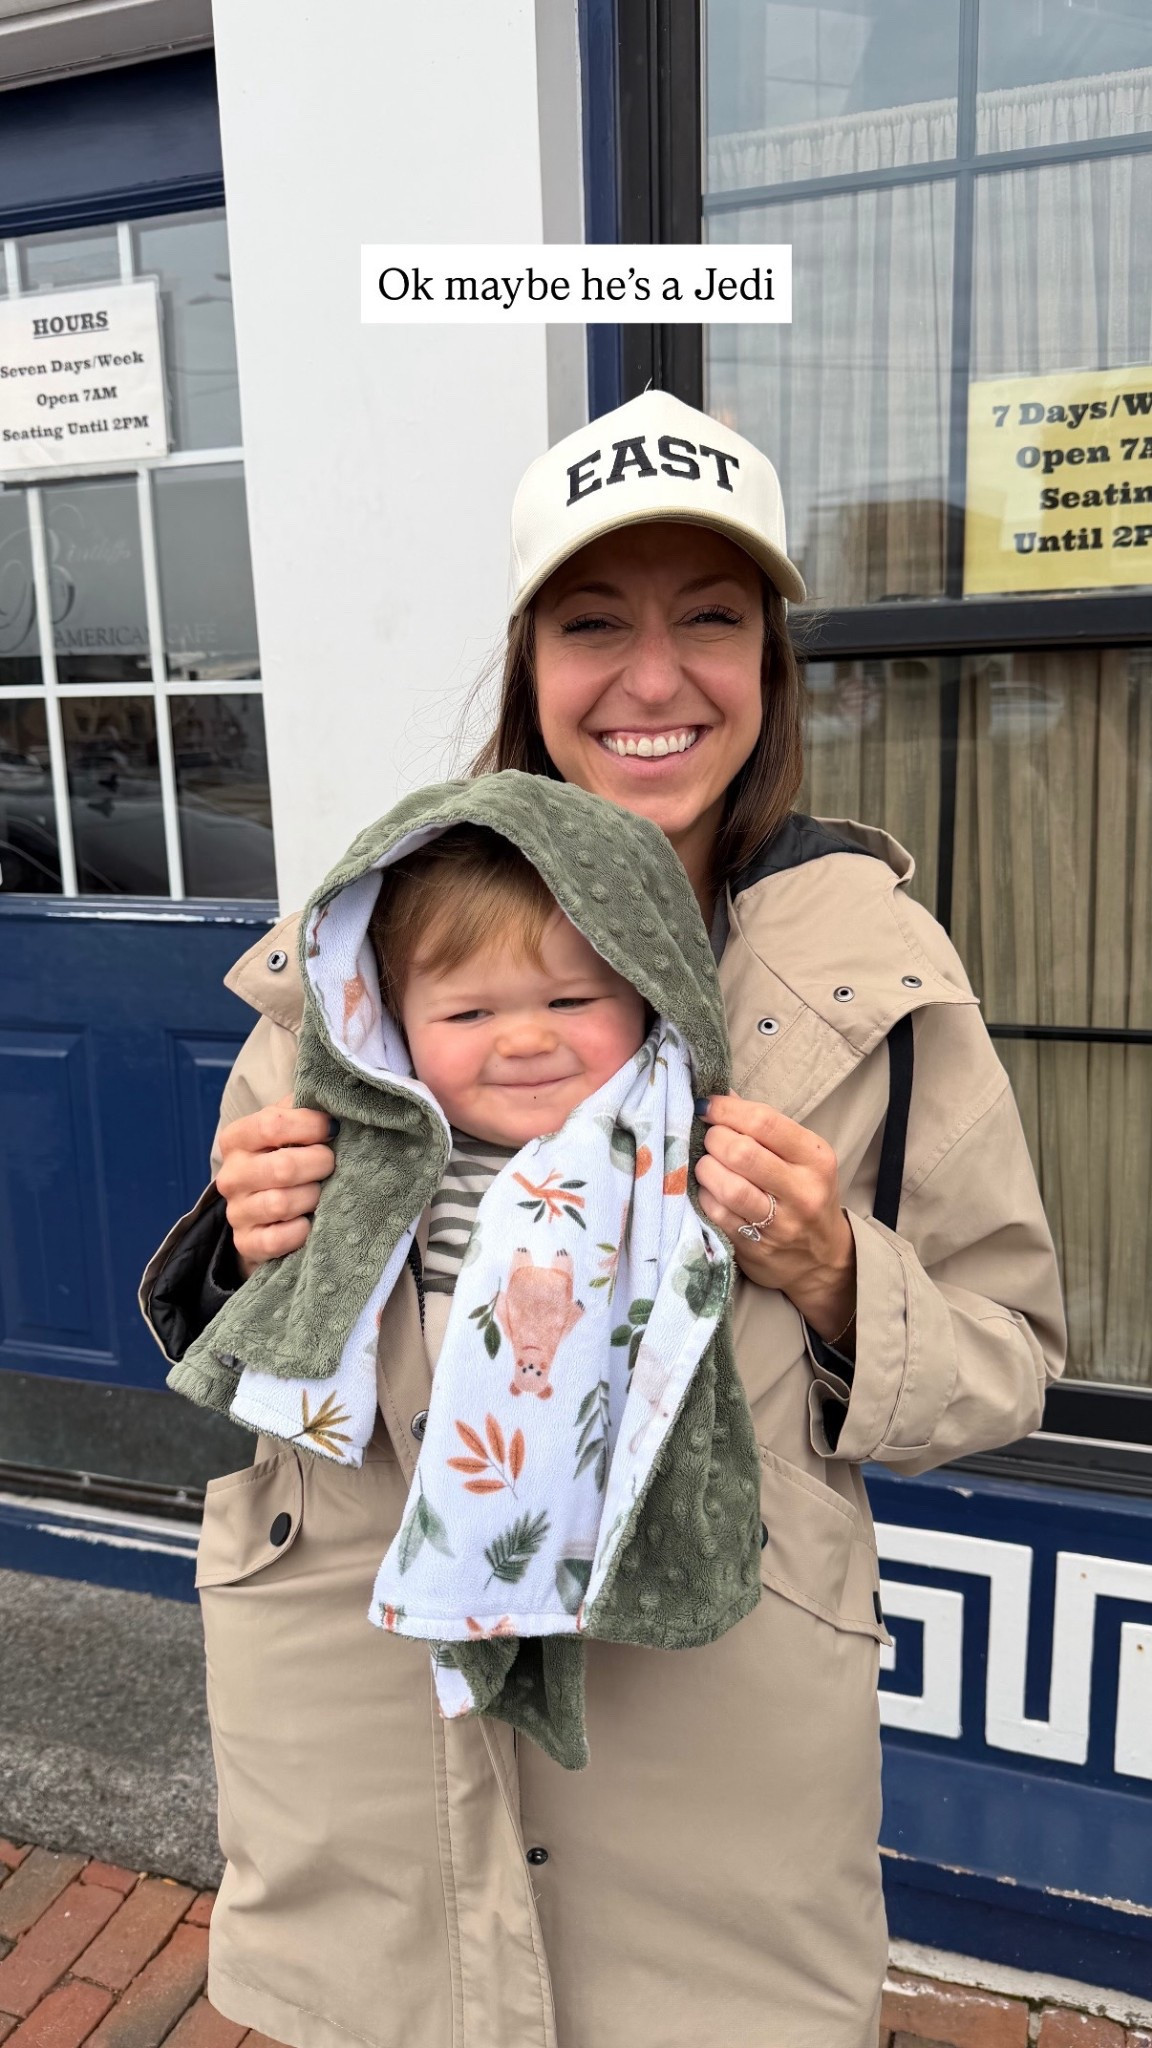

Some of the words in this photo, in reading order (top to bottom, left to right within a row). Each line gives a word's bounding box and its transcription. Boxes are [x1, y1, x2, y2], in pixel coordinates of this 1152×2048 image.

[33, 310, 109, 337] HOURS
[0, 361, 47, 379] Seven
[51, 350, 144, 375] Days/Week
[37, 391, 79, 410] Open
[83, 385, 118, 402] 7AM
[3, 421, 63, 442] Seating
[67, 417, 109, 435] Until
[112, 415, 149, 431] 2PM
[991, 404, 1010, 428] 7
[566, 434, 740, 507] EAST
[1016, 444, 1110, 474] Open
[1014, 527, 1103, 554] Until
[54, 623, 149, 648] AMERICA
